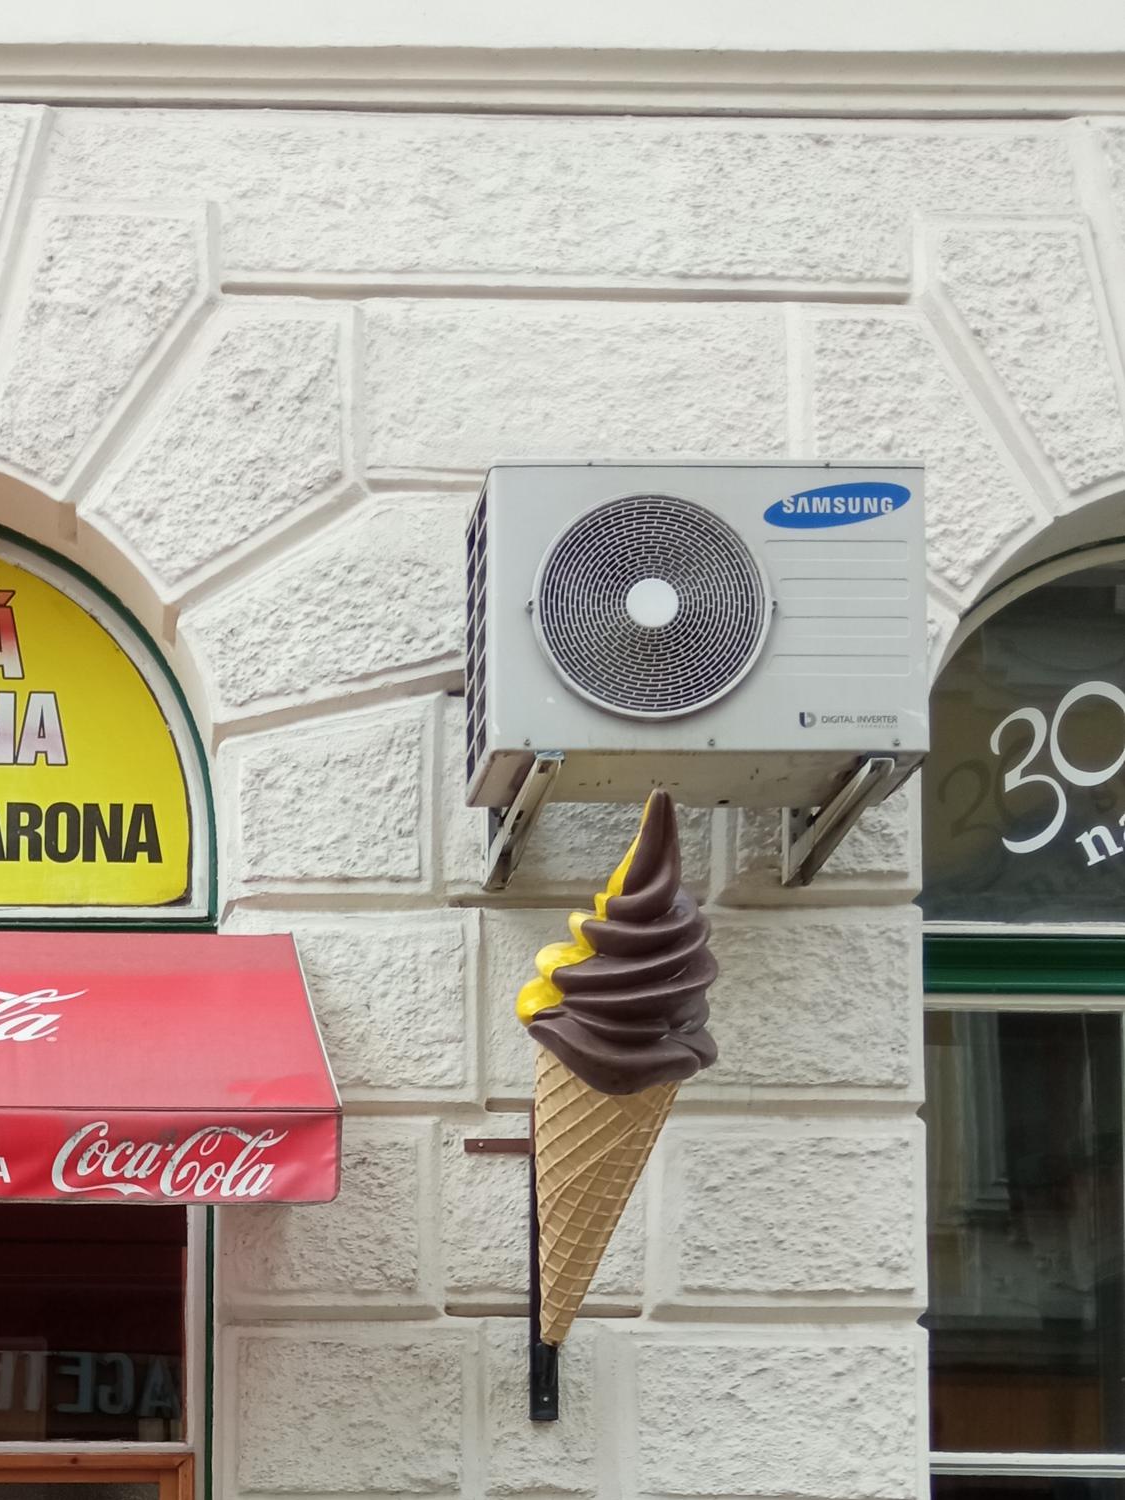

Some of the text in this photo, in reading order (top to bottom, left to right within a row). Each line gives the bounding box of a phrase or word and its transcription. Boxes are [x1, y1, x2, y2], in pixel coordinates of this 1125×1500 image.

[782, 496, 894, 514] SAMSUNG
[821, 715, 898, 724] DIGITAL INVERTER
[1075, 812, 1125, 867] n
[52, 1121, 289, 1198] Coca-Cola
